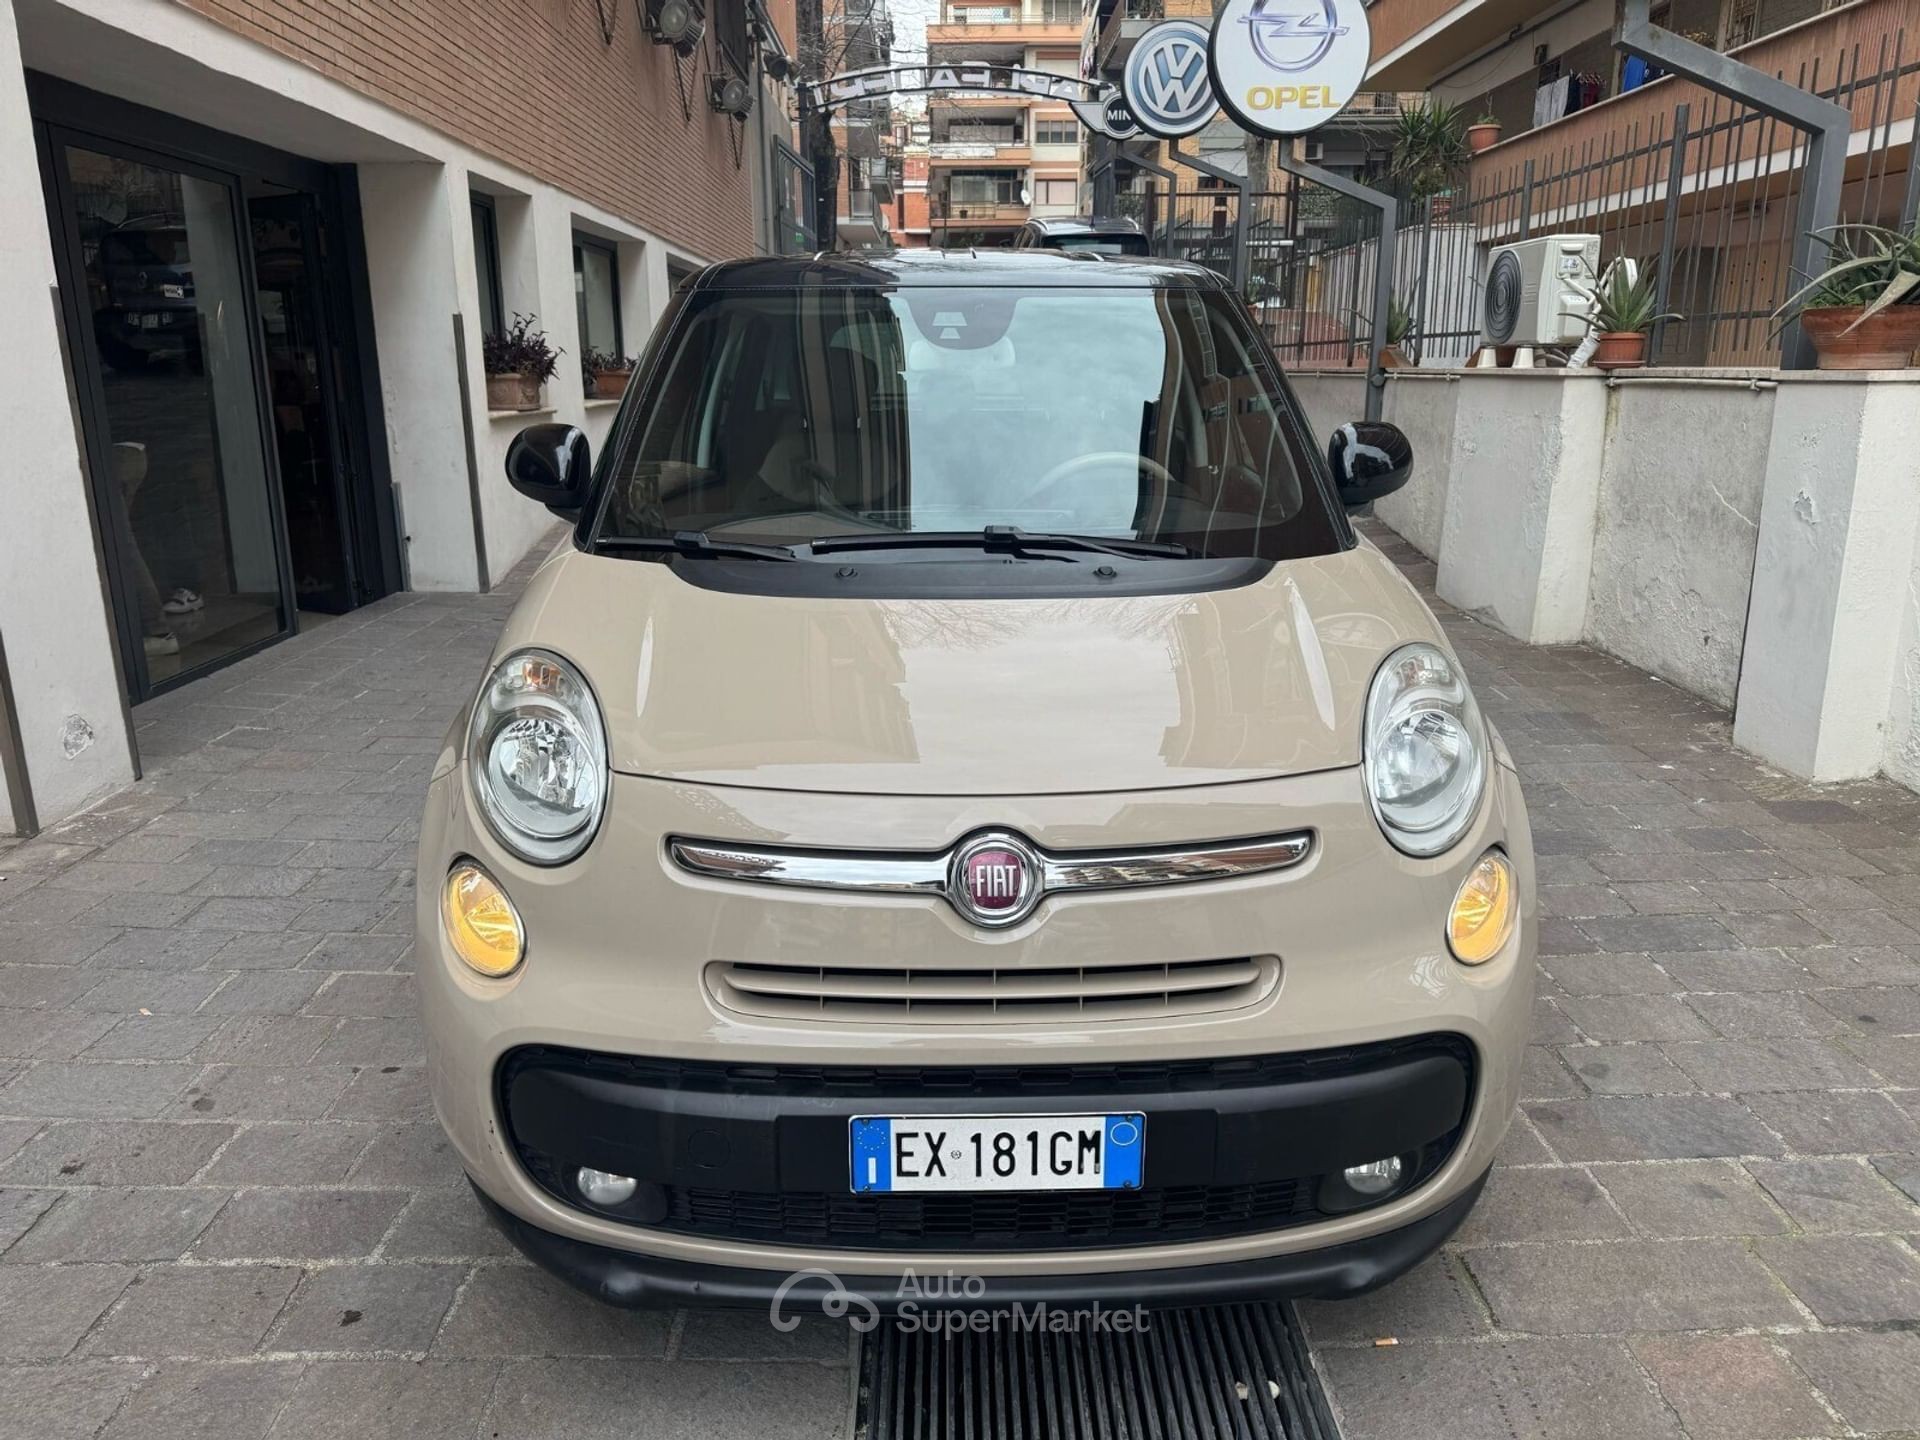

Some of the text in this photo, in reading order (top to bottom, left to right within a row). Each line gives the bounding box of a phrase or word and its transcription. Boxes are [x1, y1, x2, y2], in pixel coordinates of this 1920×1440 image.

[1247, 85, 1341, 110] OPEL
[1107, 109, 1131, 121] MIN
[976, 865, 1017, 897] FIAT
[896, 1130, 1101, 1178] EX 181GM
